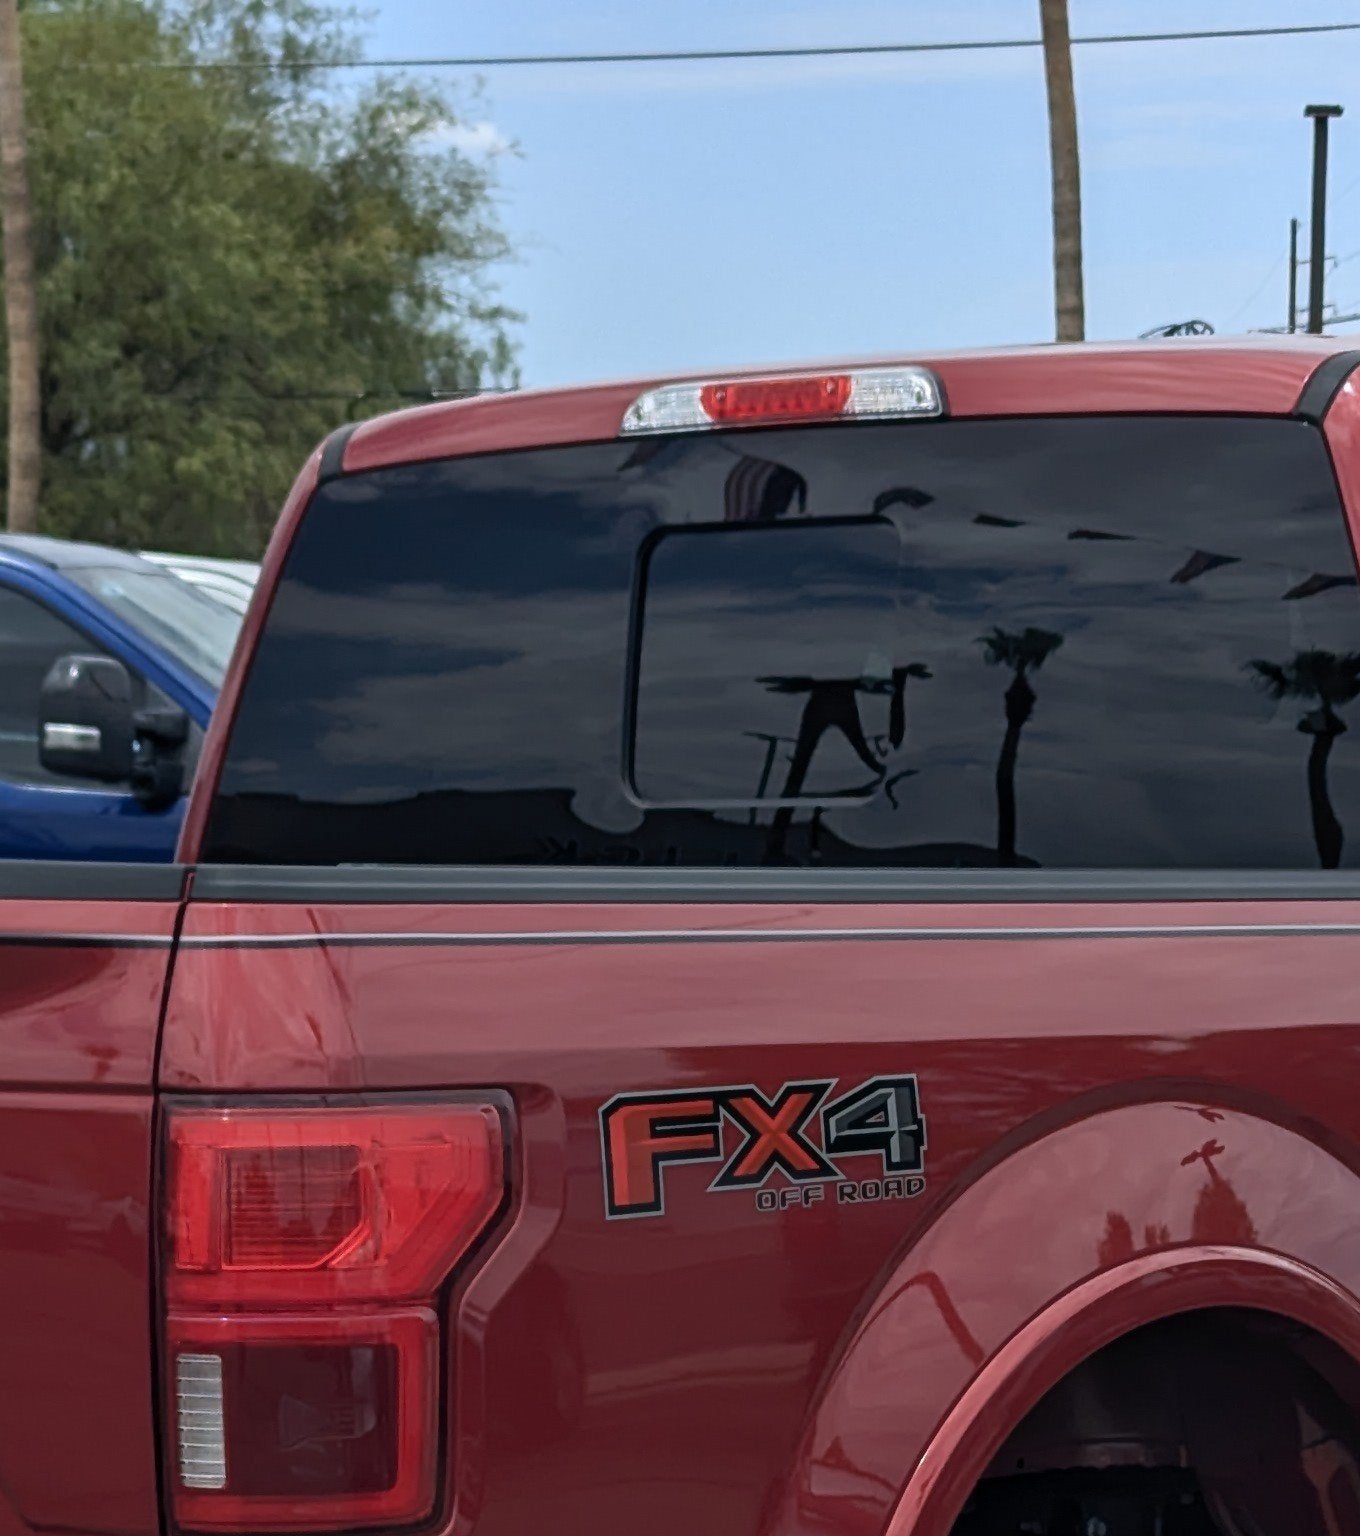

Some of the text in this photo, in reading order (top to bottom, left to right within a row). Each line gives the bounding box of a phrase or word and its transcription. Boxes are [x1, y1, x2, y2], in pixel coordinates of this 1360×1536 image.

[598, 1073, 927, 1220] FX4
[755, 1176, 927, 1212] OFF ROAD
